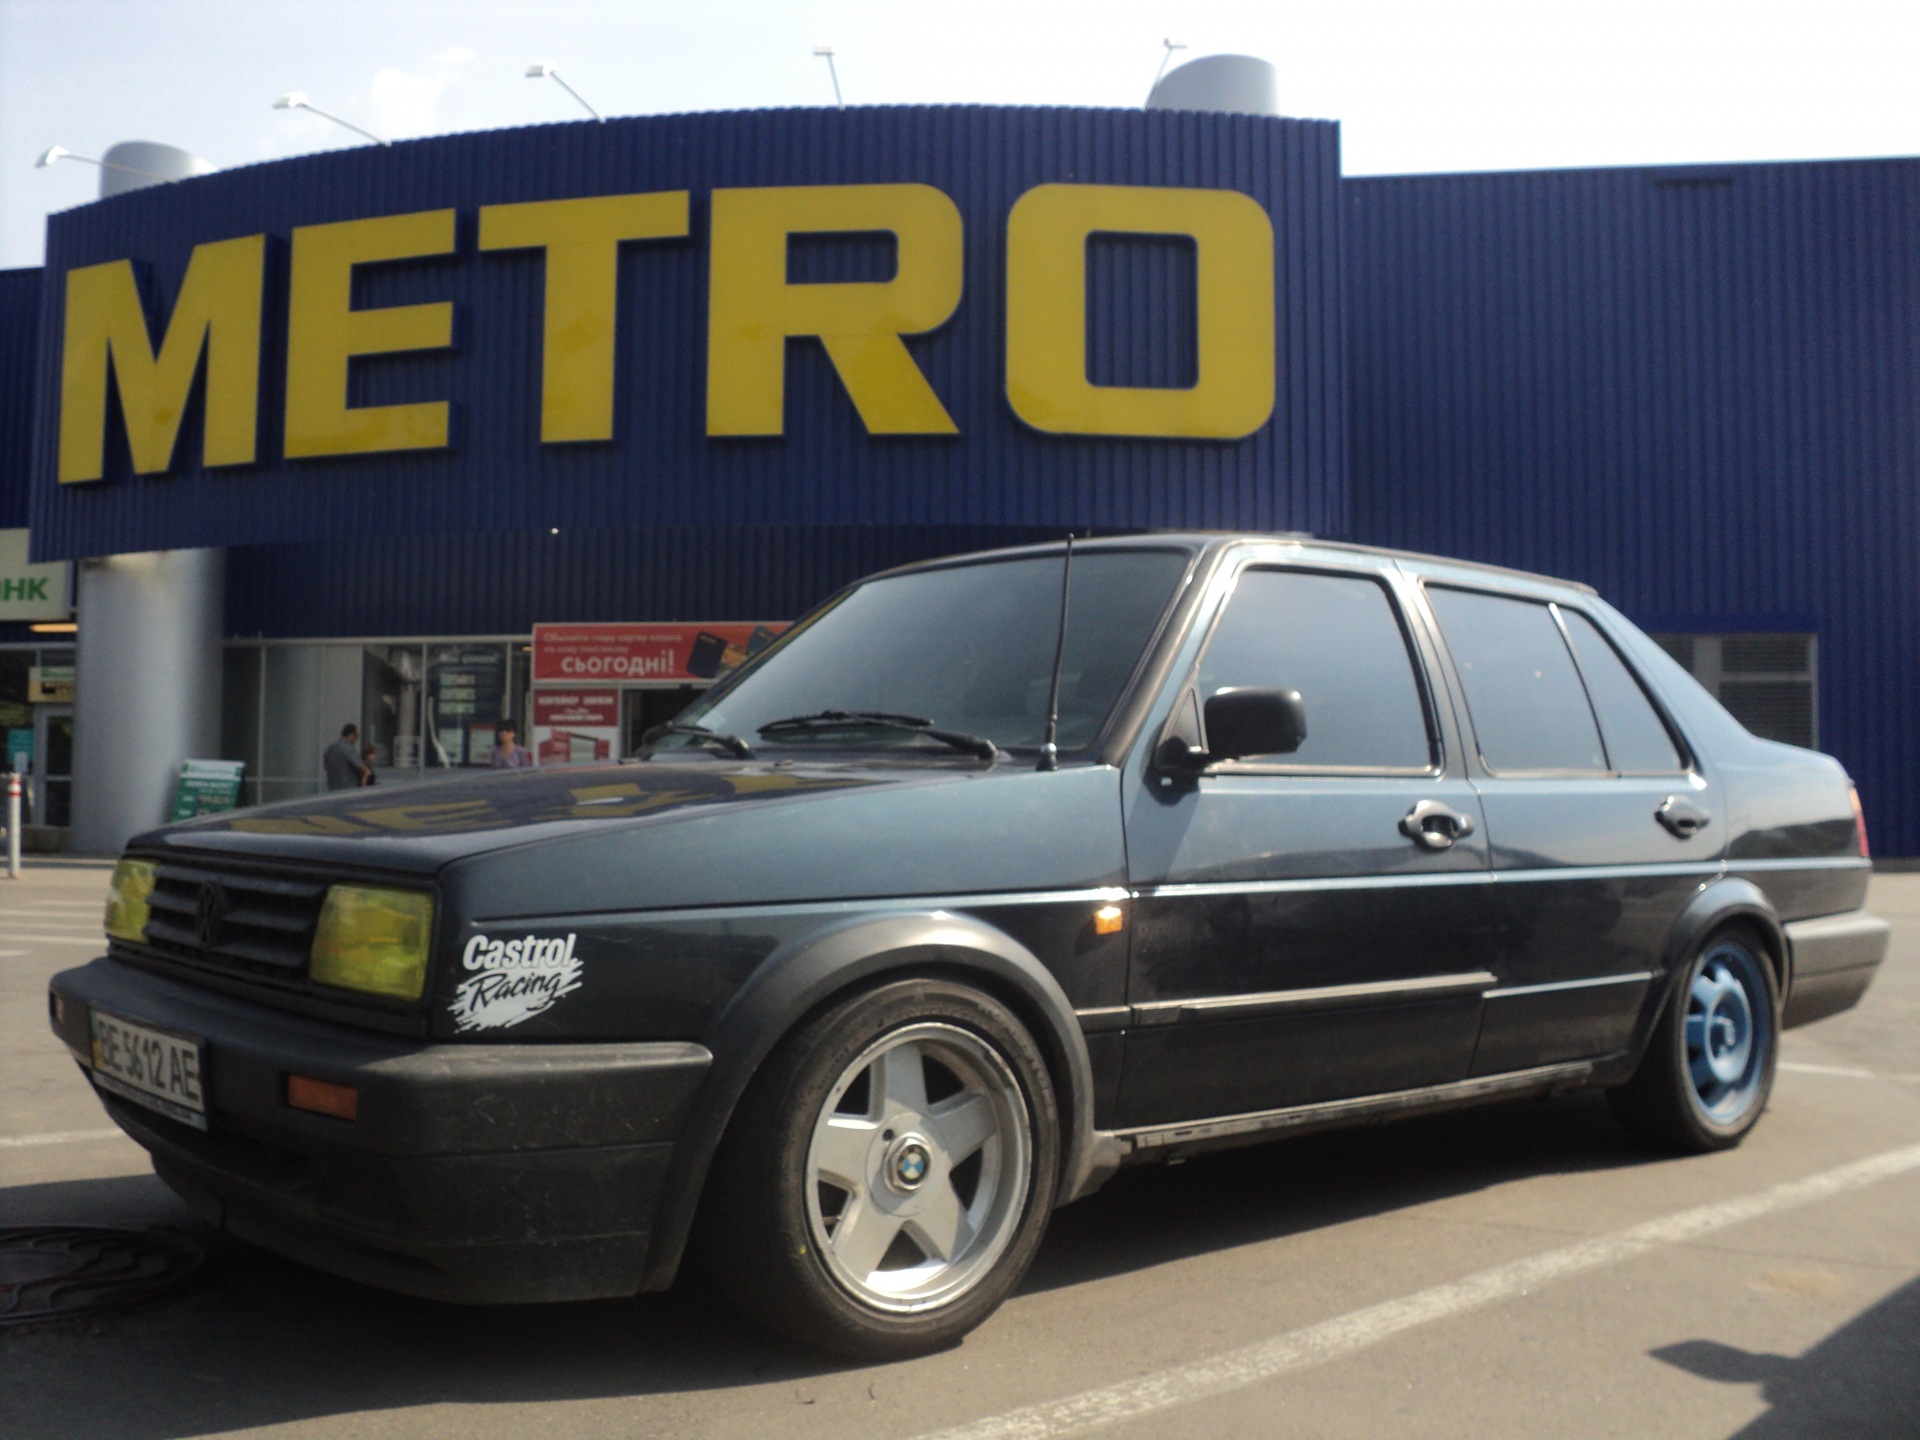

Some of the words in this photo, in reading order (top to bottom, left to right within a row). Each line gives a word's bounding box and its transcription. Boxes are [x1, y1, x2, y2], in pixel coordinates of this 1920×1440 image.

[58, 182, 1275, 484] METRO
[0, 577, 49, 601] НК
[561, 649, 675, 676] сьогодні!
[462, 932, 577, 971] Castrol
[468, 971, 562, 1012] Racing
